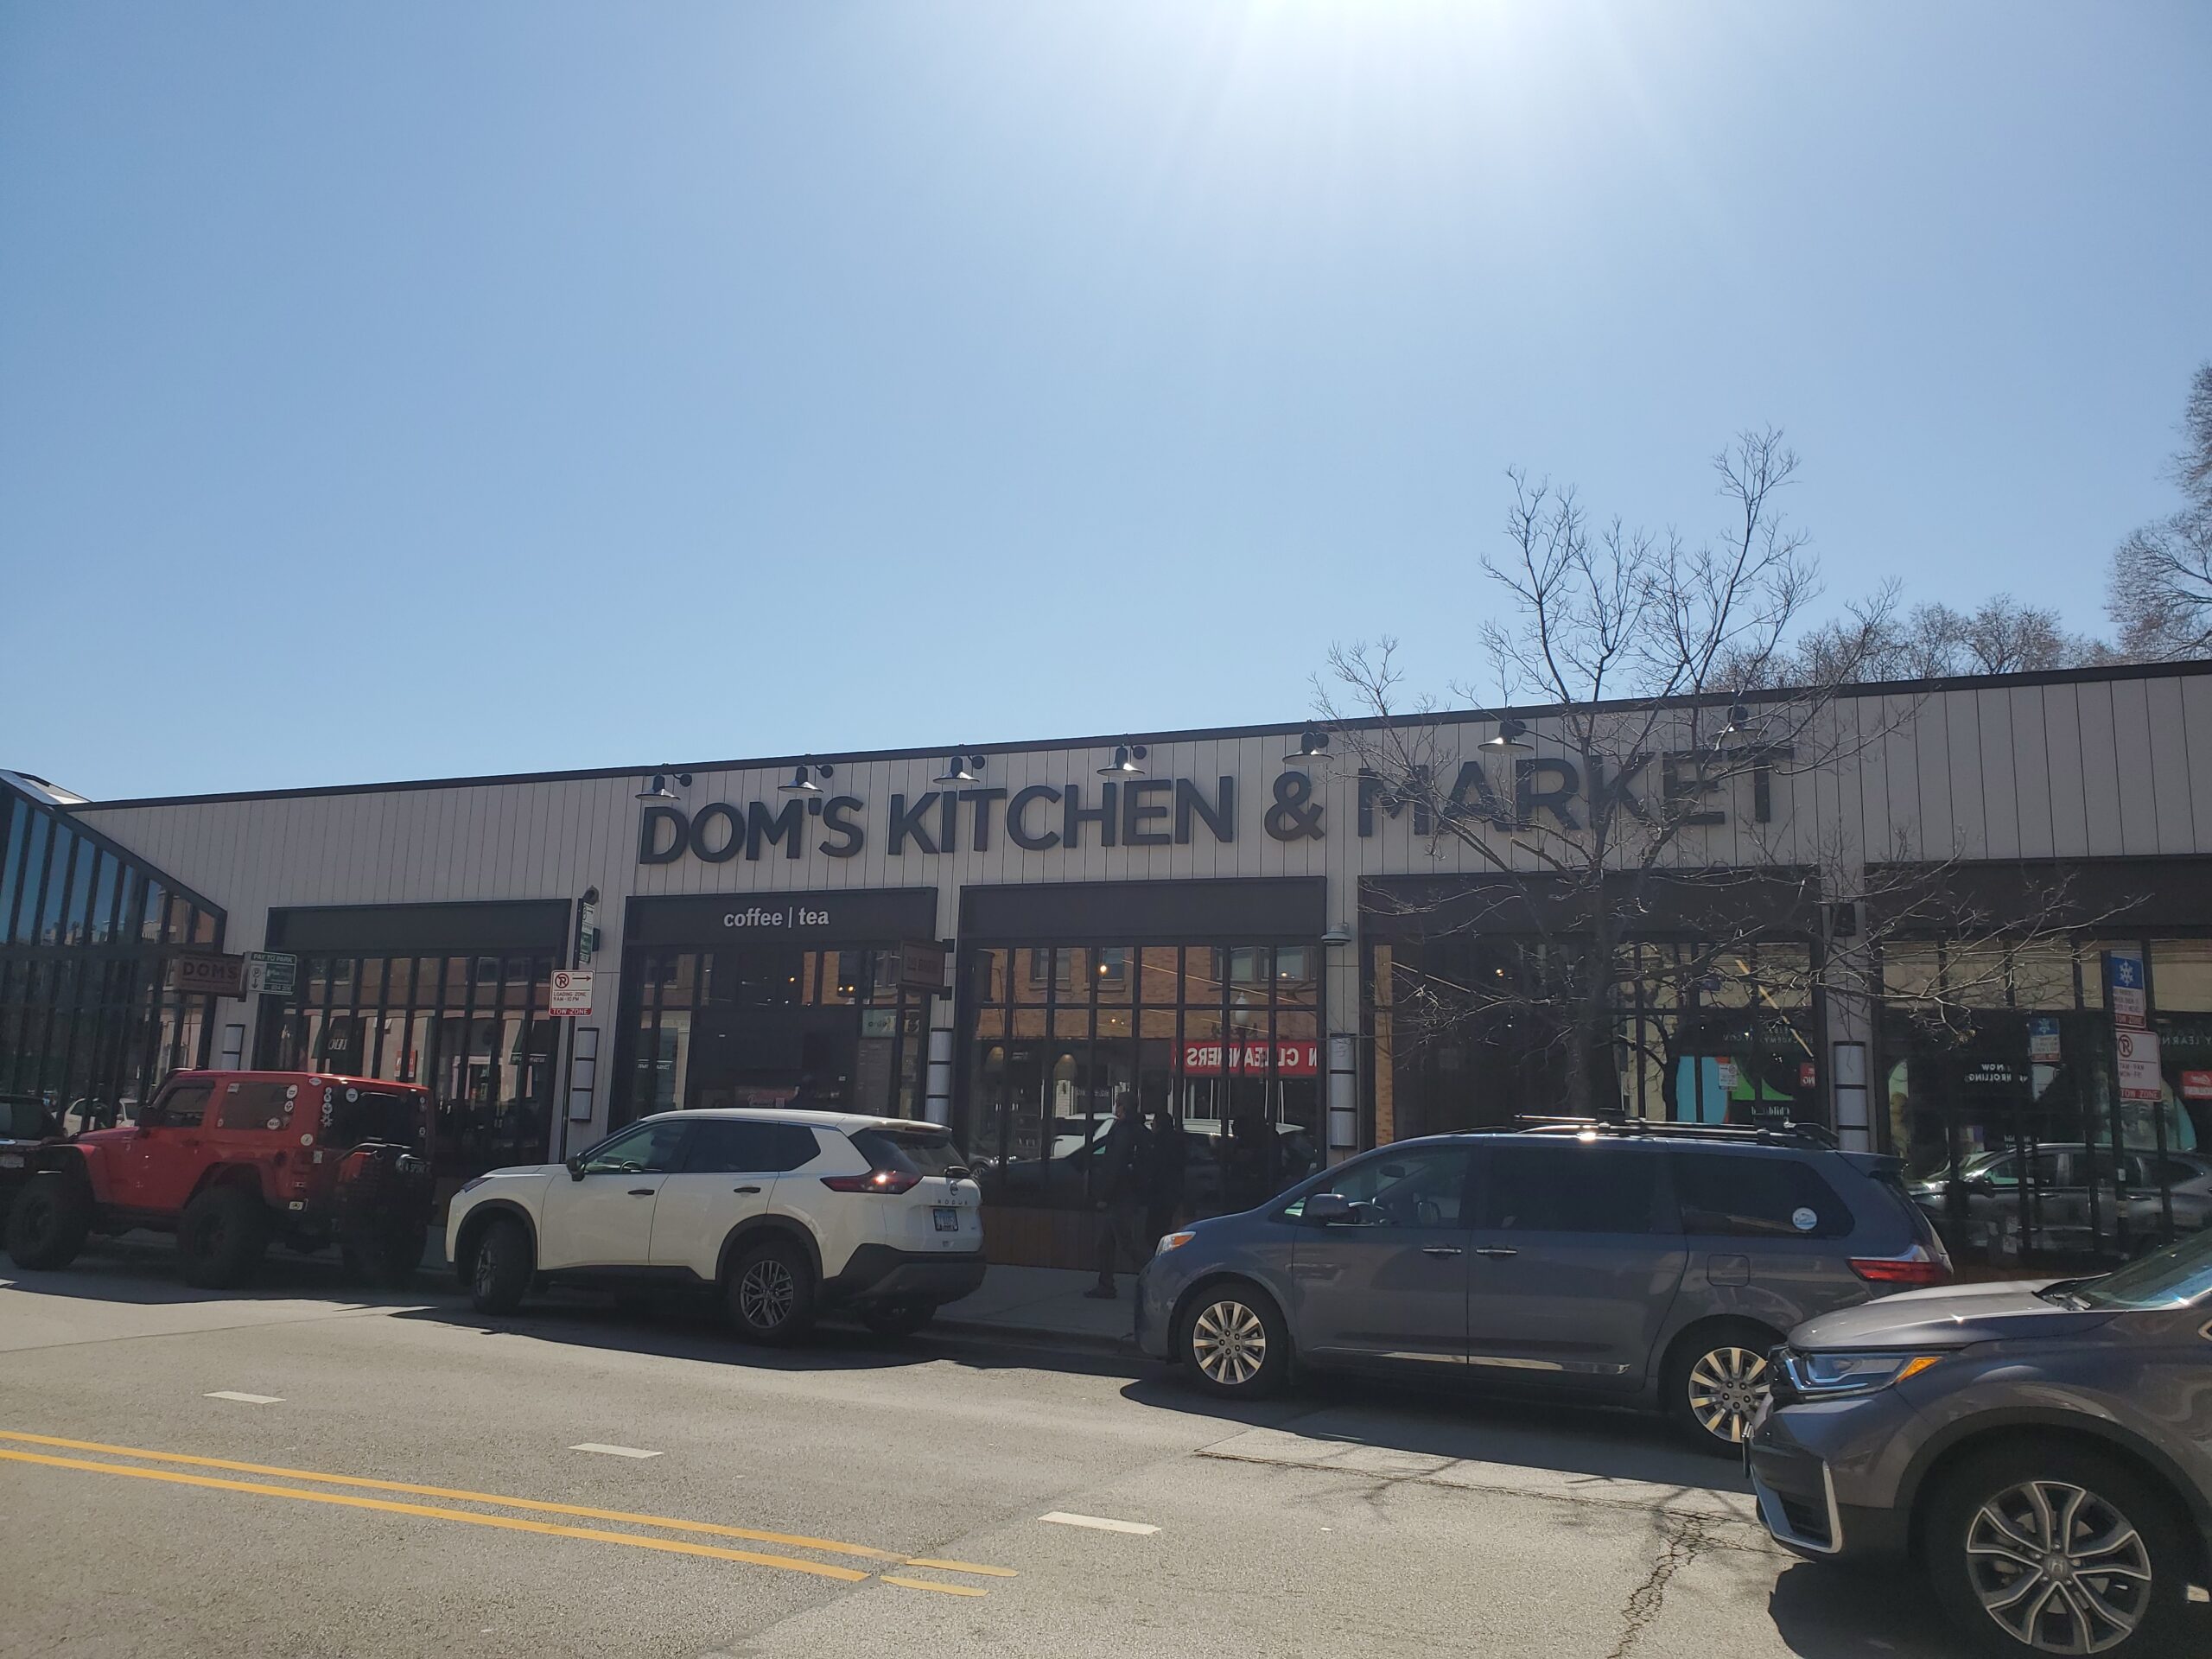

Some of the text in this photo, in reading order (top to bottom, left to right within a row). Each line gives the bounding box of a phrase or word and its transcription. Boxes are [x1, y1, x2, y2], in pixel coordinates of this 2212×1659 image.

[639, 747, 1795, 864] DOM'S KITCHEN & MARKET
[723, 907, 783, 927] coffee
[798, 909, 830, 926] tea
[276, 955, 293, 963] PARK
[2121, 1089, 2159, 1100] TOW ZONE
